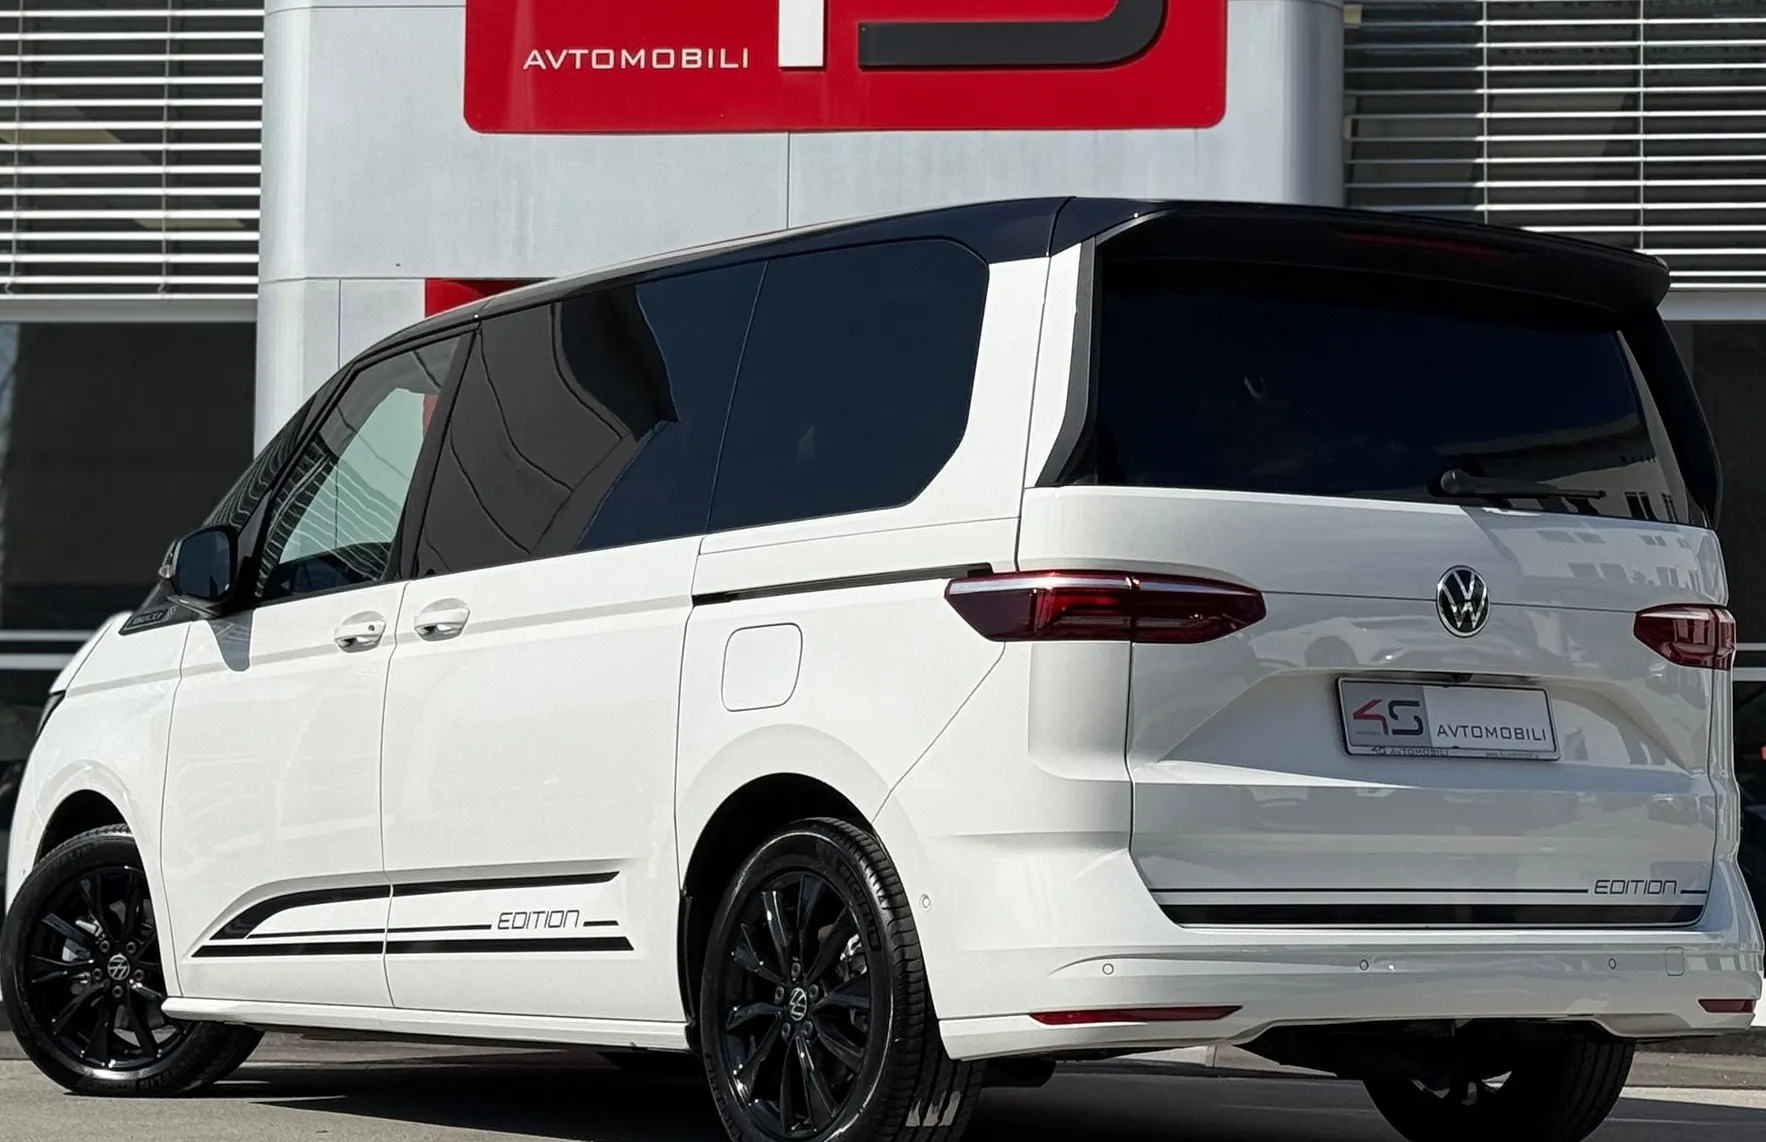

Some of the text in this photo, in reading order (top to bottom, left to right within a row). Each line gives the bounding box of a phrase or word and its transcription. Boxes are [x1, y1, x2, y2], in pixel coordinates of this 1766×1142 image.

[523, 47, 750, 71] AVTOMOBILI
[1436, 724, 1547, 742] AVTOMOBILI
[1594, 879, 1678, 895] EDITION
[497, 909, 580, 930] EDITION
